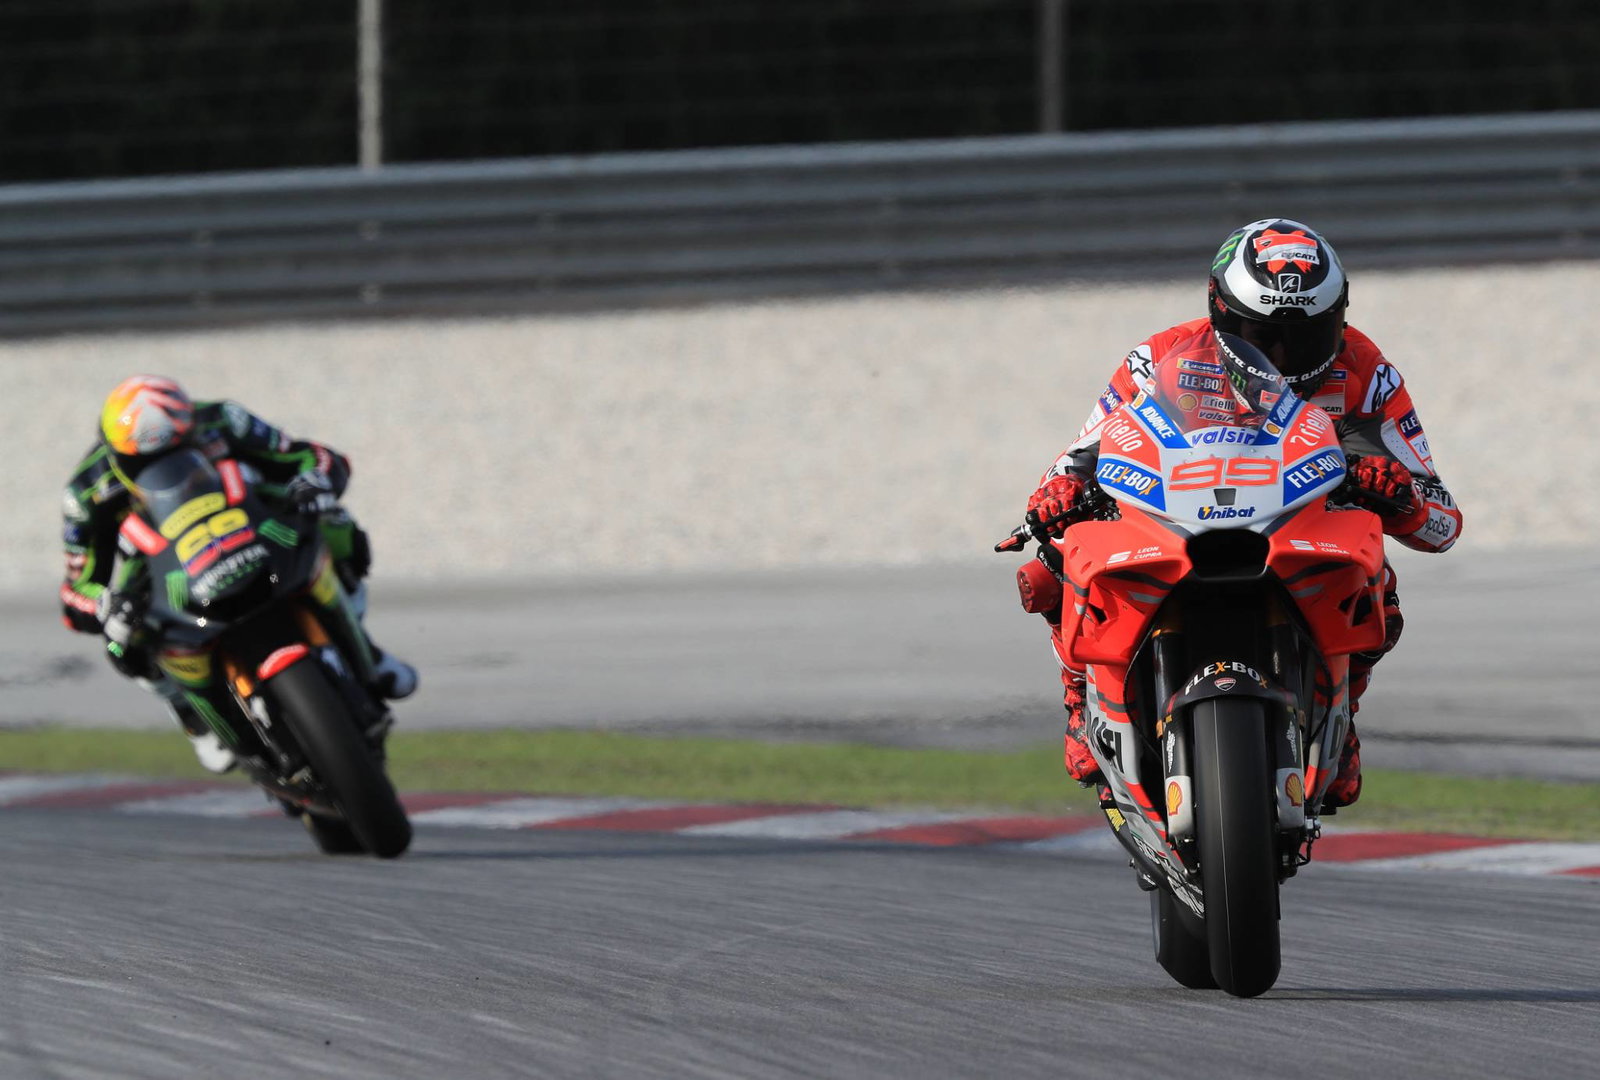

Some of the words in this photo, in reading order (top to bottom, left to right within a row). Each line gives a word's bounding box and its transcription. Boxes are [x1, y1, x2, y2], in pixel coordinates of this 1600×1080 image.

[1259, 294, 1317, 306] SHARK
[1140, 403, 1176, 439] ADVANCE
[1192, 427, 1256, 445] valsir
[1097, 462, 1160, 496] FLEX-BOX
[1168, 456, 1280, 491] 99
[1286, 452, 1344, 489] FLEX-BOX
[1197, 505, 1256, 520] Unibat
[1133, 551, 1163, 560] CUPRA
[1184, 660, 1269, 696] FLEX-BOX
